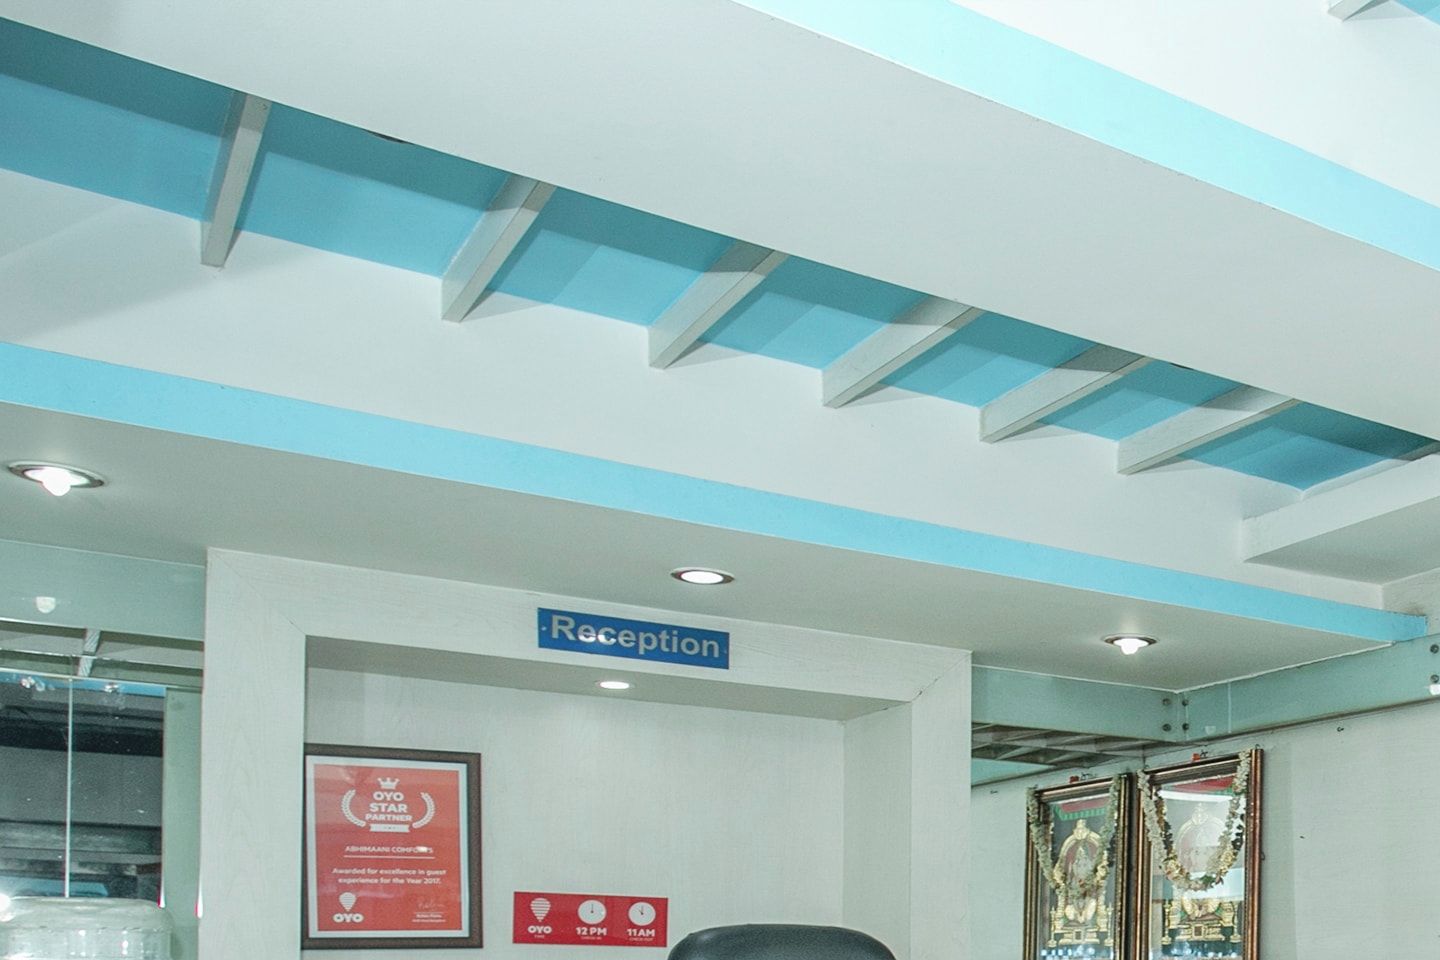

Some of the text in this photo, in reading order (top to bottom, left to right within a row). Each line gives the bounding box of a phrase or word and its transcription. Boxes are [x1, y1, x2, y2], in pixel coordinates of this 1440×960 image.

[551, 615, 719, 658] Reception
[373, 791, 404, 801] OYO
[369, 803, 407, 813] STAR
[365, 813, 412, 822] PARTNER
[332, 913, 364, 923] OYO
[527, 925, 552, 934] OYO
[576, 927, 607, 936] 12 PM
[638, 929, 655, 937] AM
